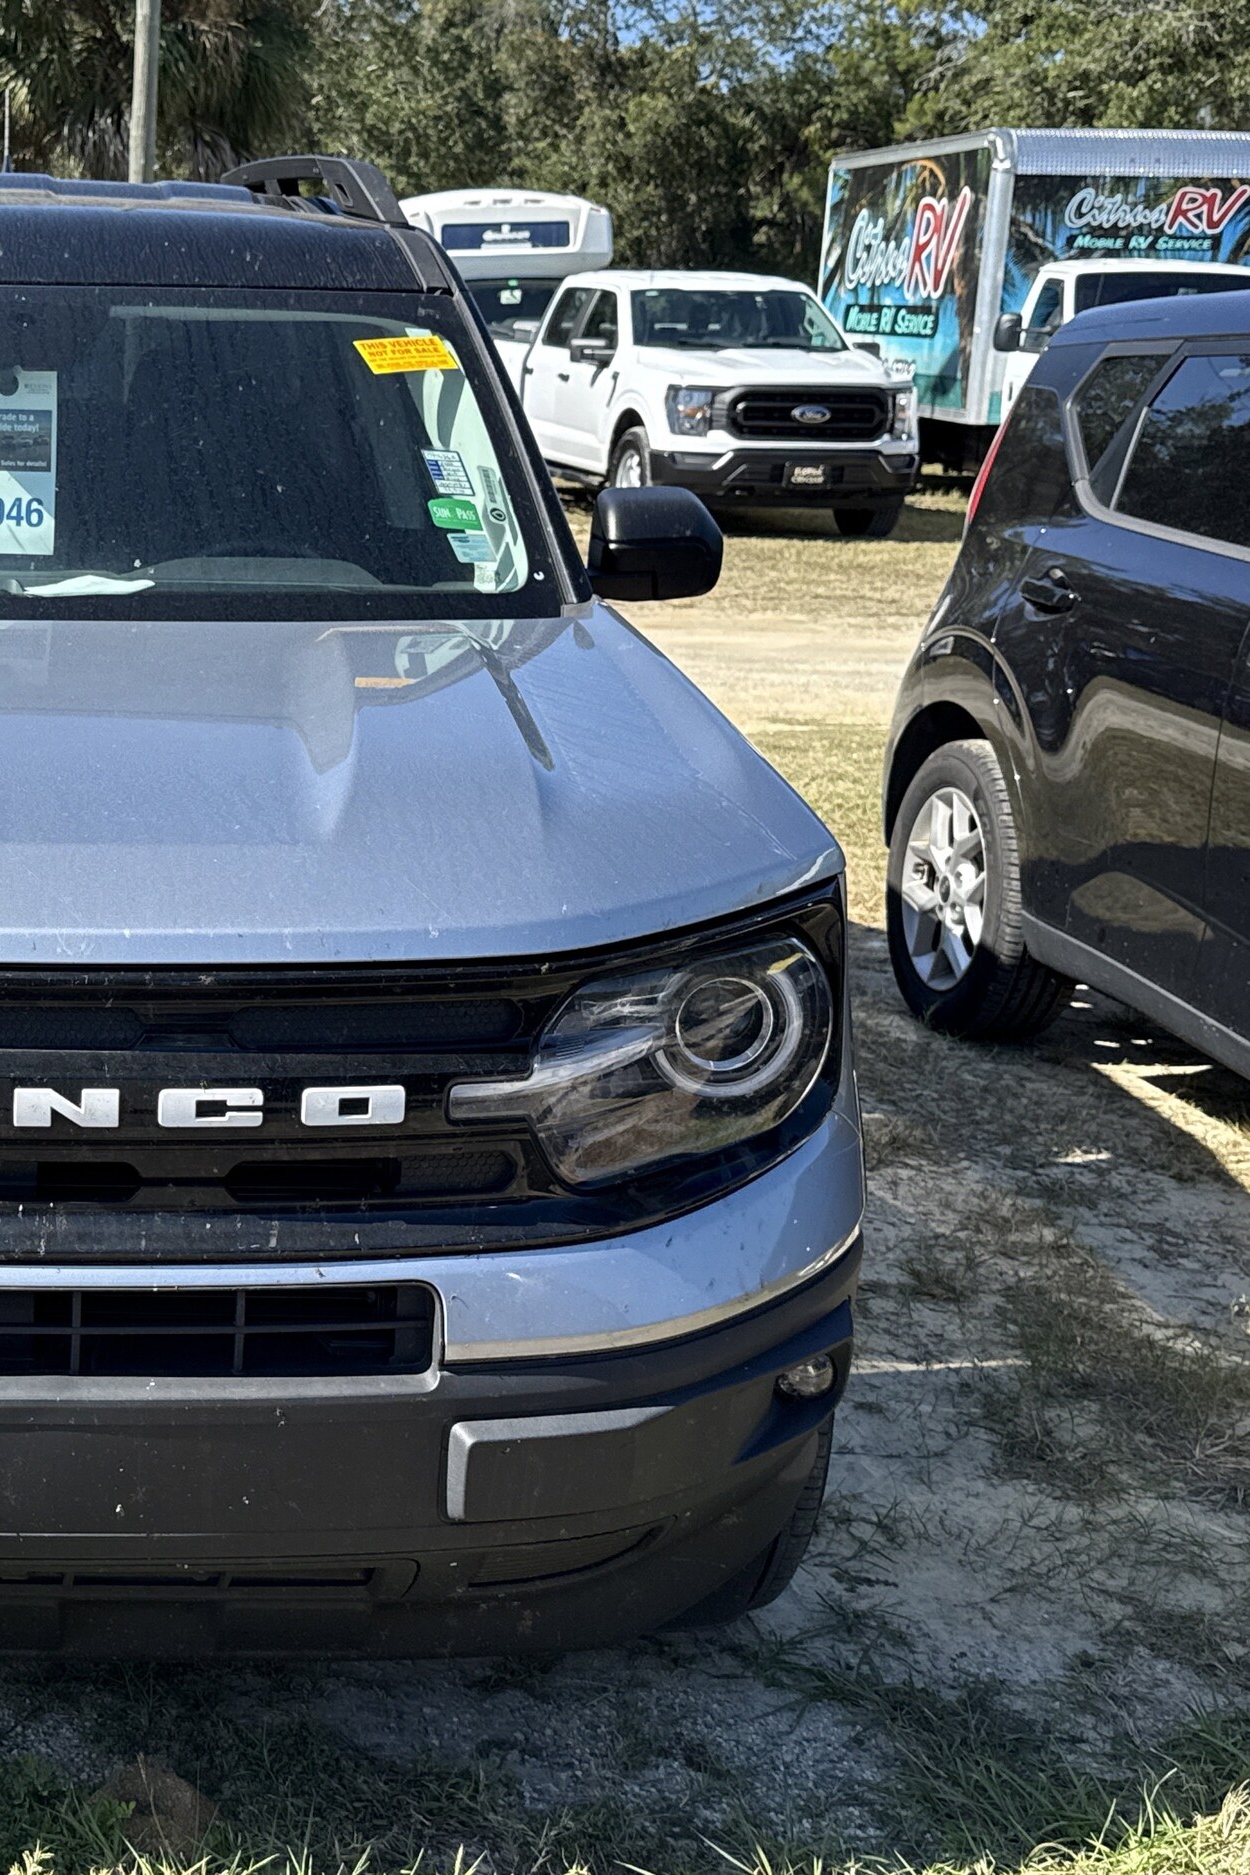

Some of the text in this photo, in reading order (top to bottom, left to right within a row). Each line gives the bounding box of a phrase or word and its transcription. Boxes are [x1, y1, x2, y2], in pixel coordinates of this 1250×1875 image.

[1065, 184, 1250, 235] Citrus RV
[845, 186, 971, 299] Citrus RV
[1128, 235, 1154, 250] RV
[879, 307, 897, 333] RV
[359, 338, 439, 351] THIS VEHICLE
[367, 350, 389, 358] NOT
[391, 348, 413, 356] FOR
[414, 346, 441, 354] SALE
[18, 413, 27, 421] to
[14, 423, 39, 433] today!
